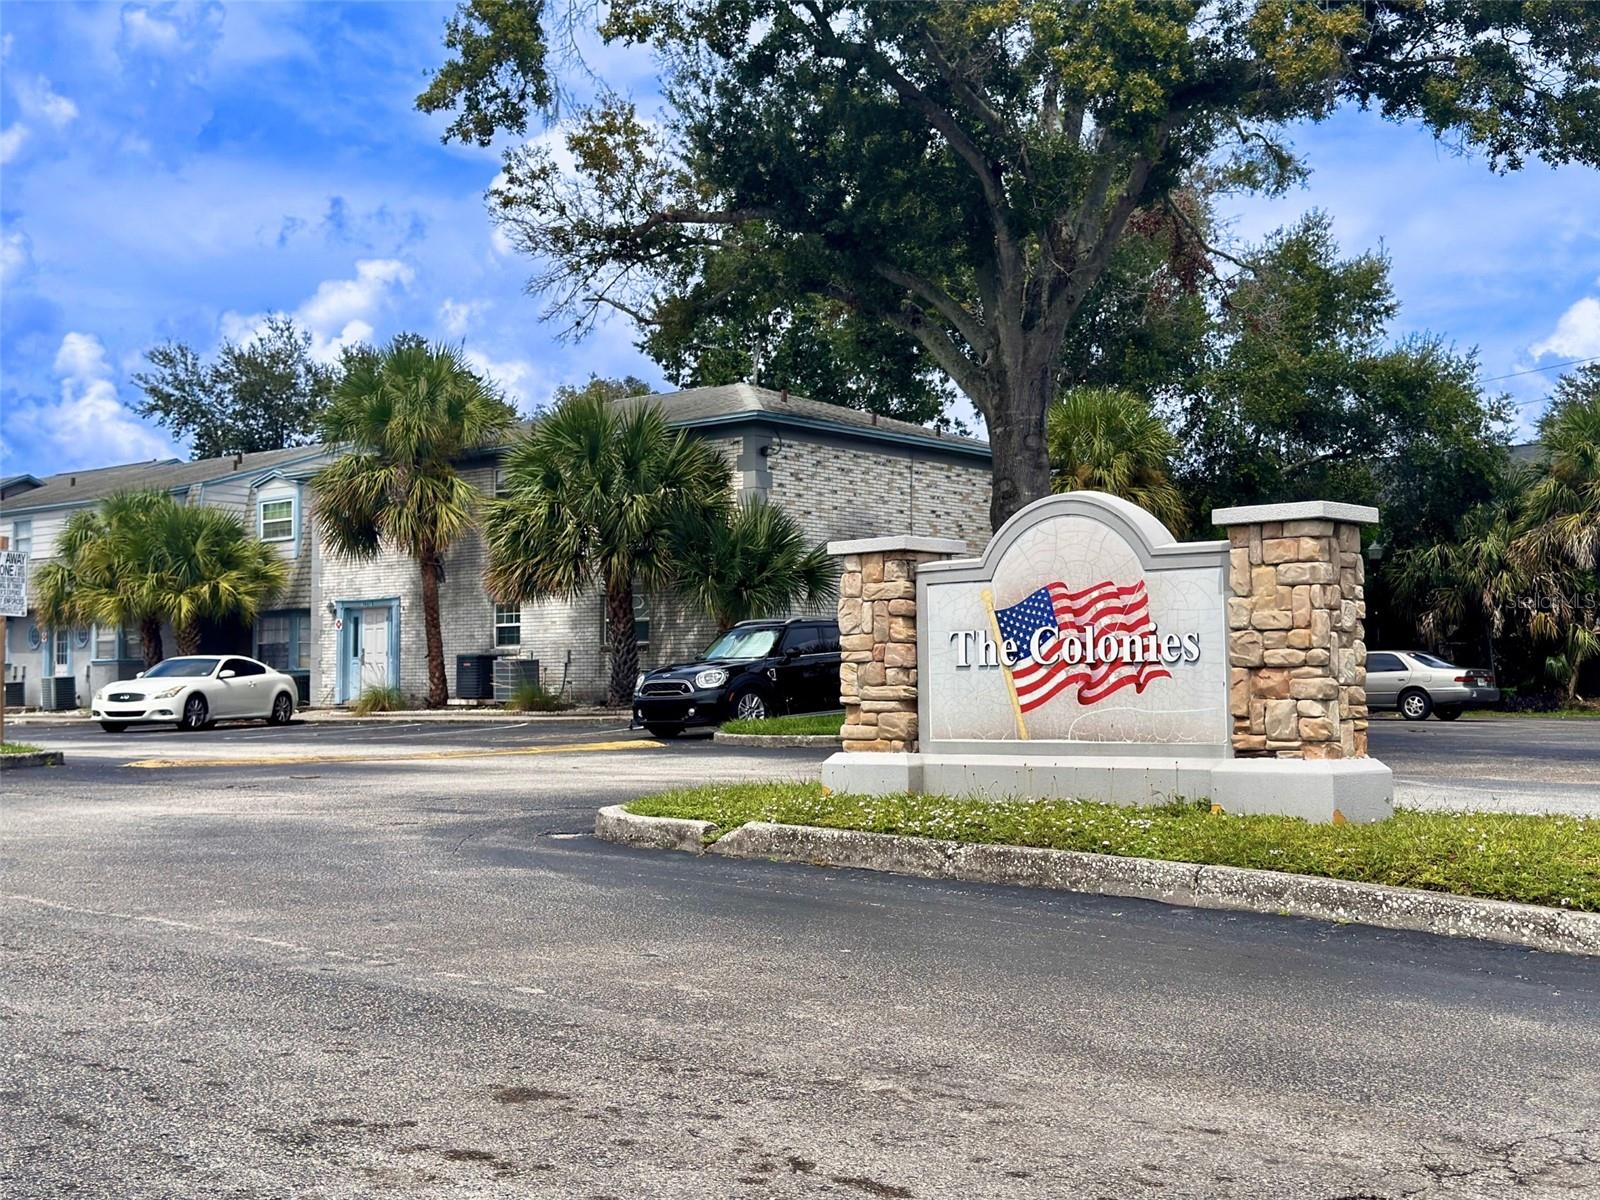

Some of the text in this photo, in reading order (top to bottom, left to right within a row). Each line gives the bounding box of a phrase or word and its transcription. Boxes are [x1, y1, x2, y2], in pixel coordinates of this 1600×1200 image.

[6, 553, 26, 564] AWAY
[949, 622, 1201, 668] The Colonies
